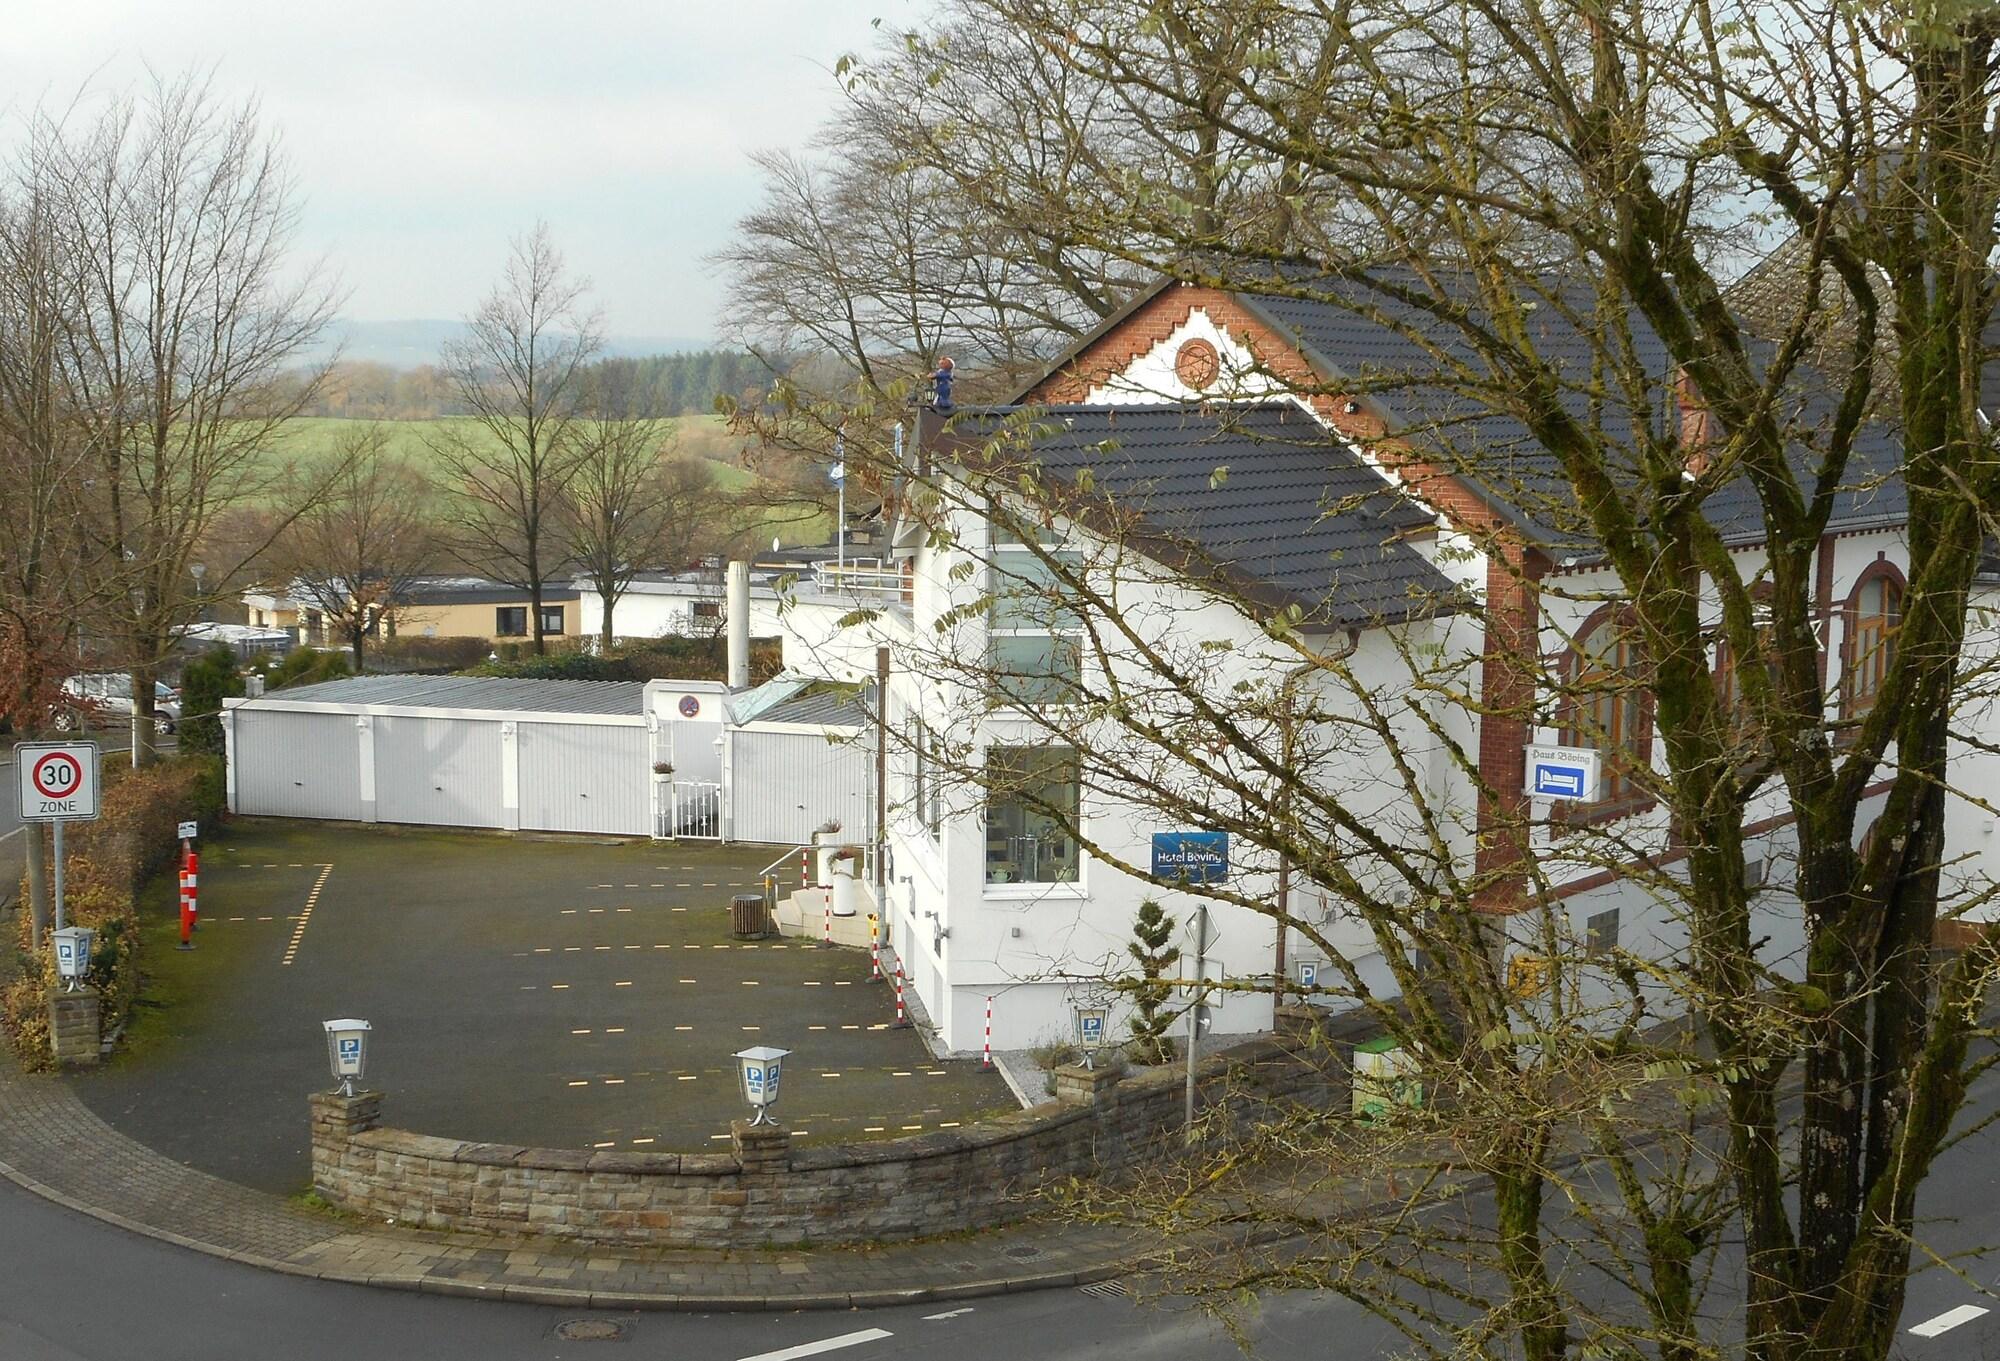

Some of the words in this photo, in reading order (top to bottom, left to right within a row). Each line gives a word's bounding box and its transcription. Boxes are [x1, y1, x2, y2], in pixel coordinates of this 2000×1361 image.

[43, 765, 71, 785] 30
[40, 801, 77, 813] ZONE
[1158, 851, 1185, 862] Hotel
[1302, 967, 1313, 984] P
